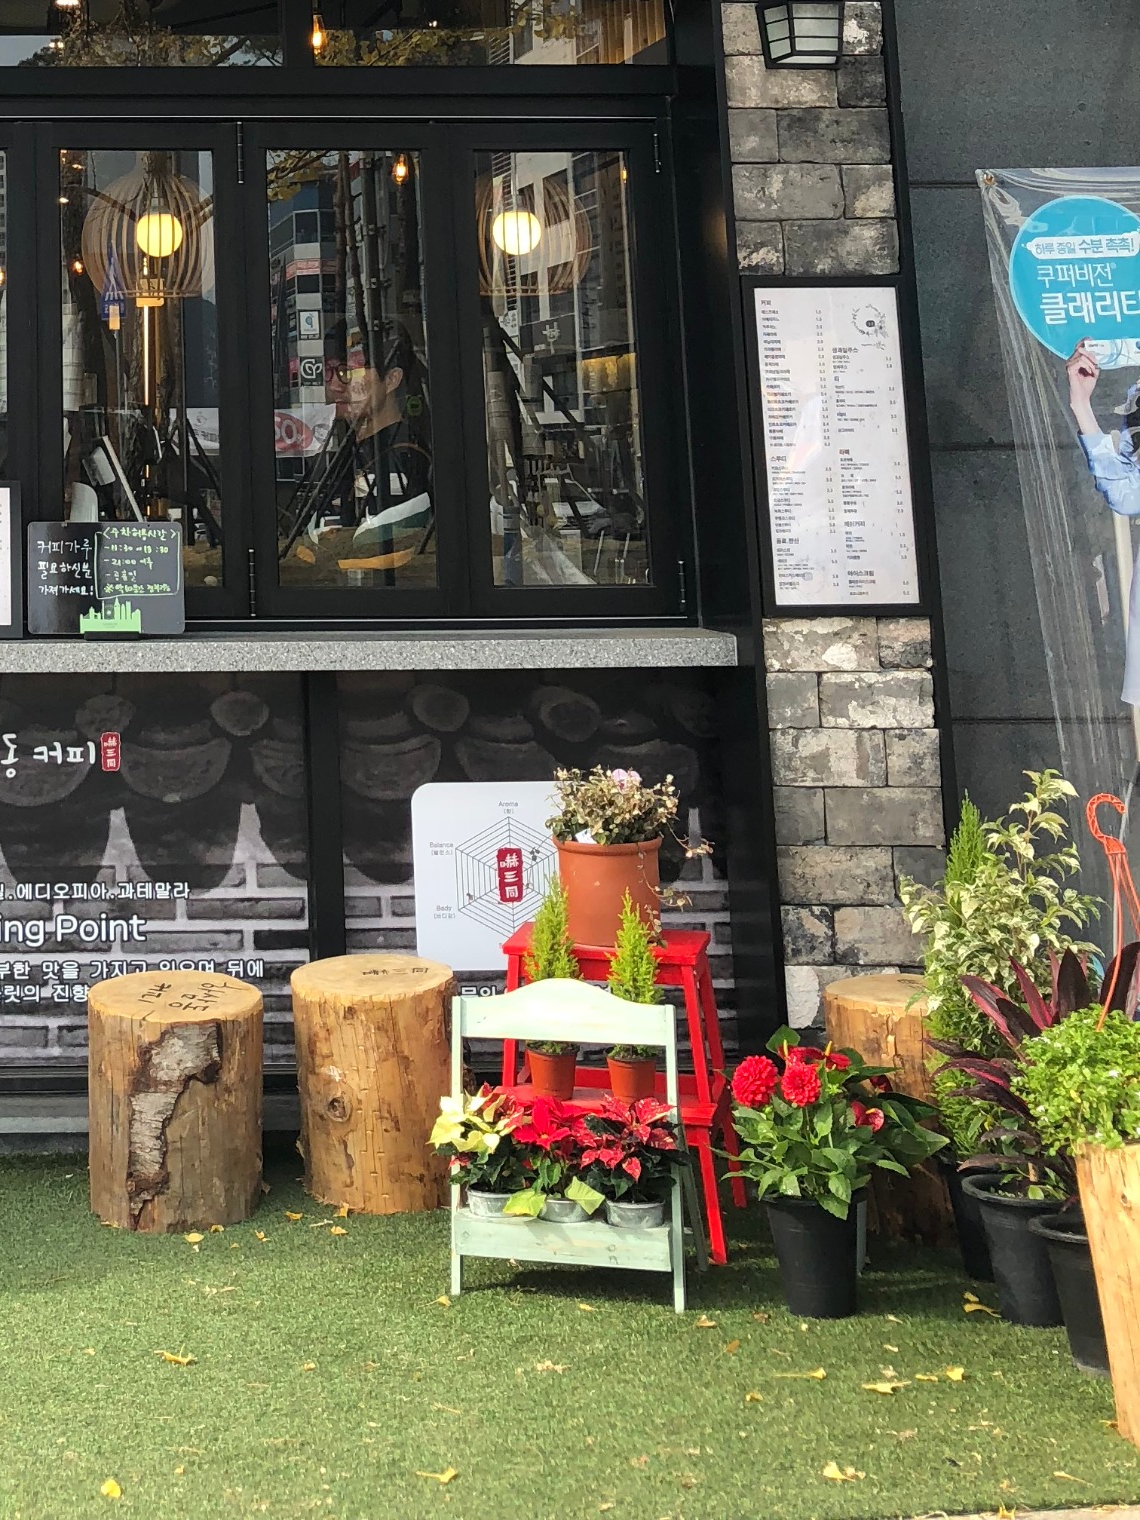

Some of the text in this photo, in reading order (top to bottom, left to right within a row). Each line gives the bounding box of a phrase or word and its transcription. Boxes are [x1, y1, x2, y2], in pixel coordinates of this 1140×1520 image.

[1035, 243, 1055, 254] 하루
[1057, 241, 1076, 254] 종일
[1079, 239, 1103, 254] 수분
[1037, 262, 1114, 288] 쿠퍼비전
[37, 539, 92, 560] 커피가루
[33, 741, 96, 764] 커피
[56, 913, 147, 942] Point
[42, 961, 80, 980] 맛을
[227, 959, 264, 978] 뒤에
